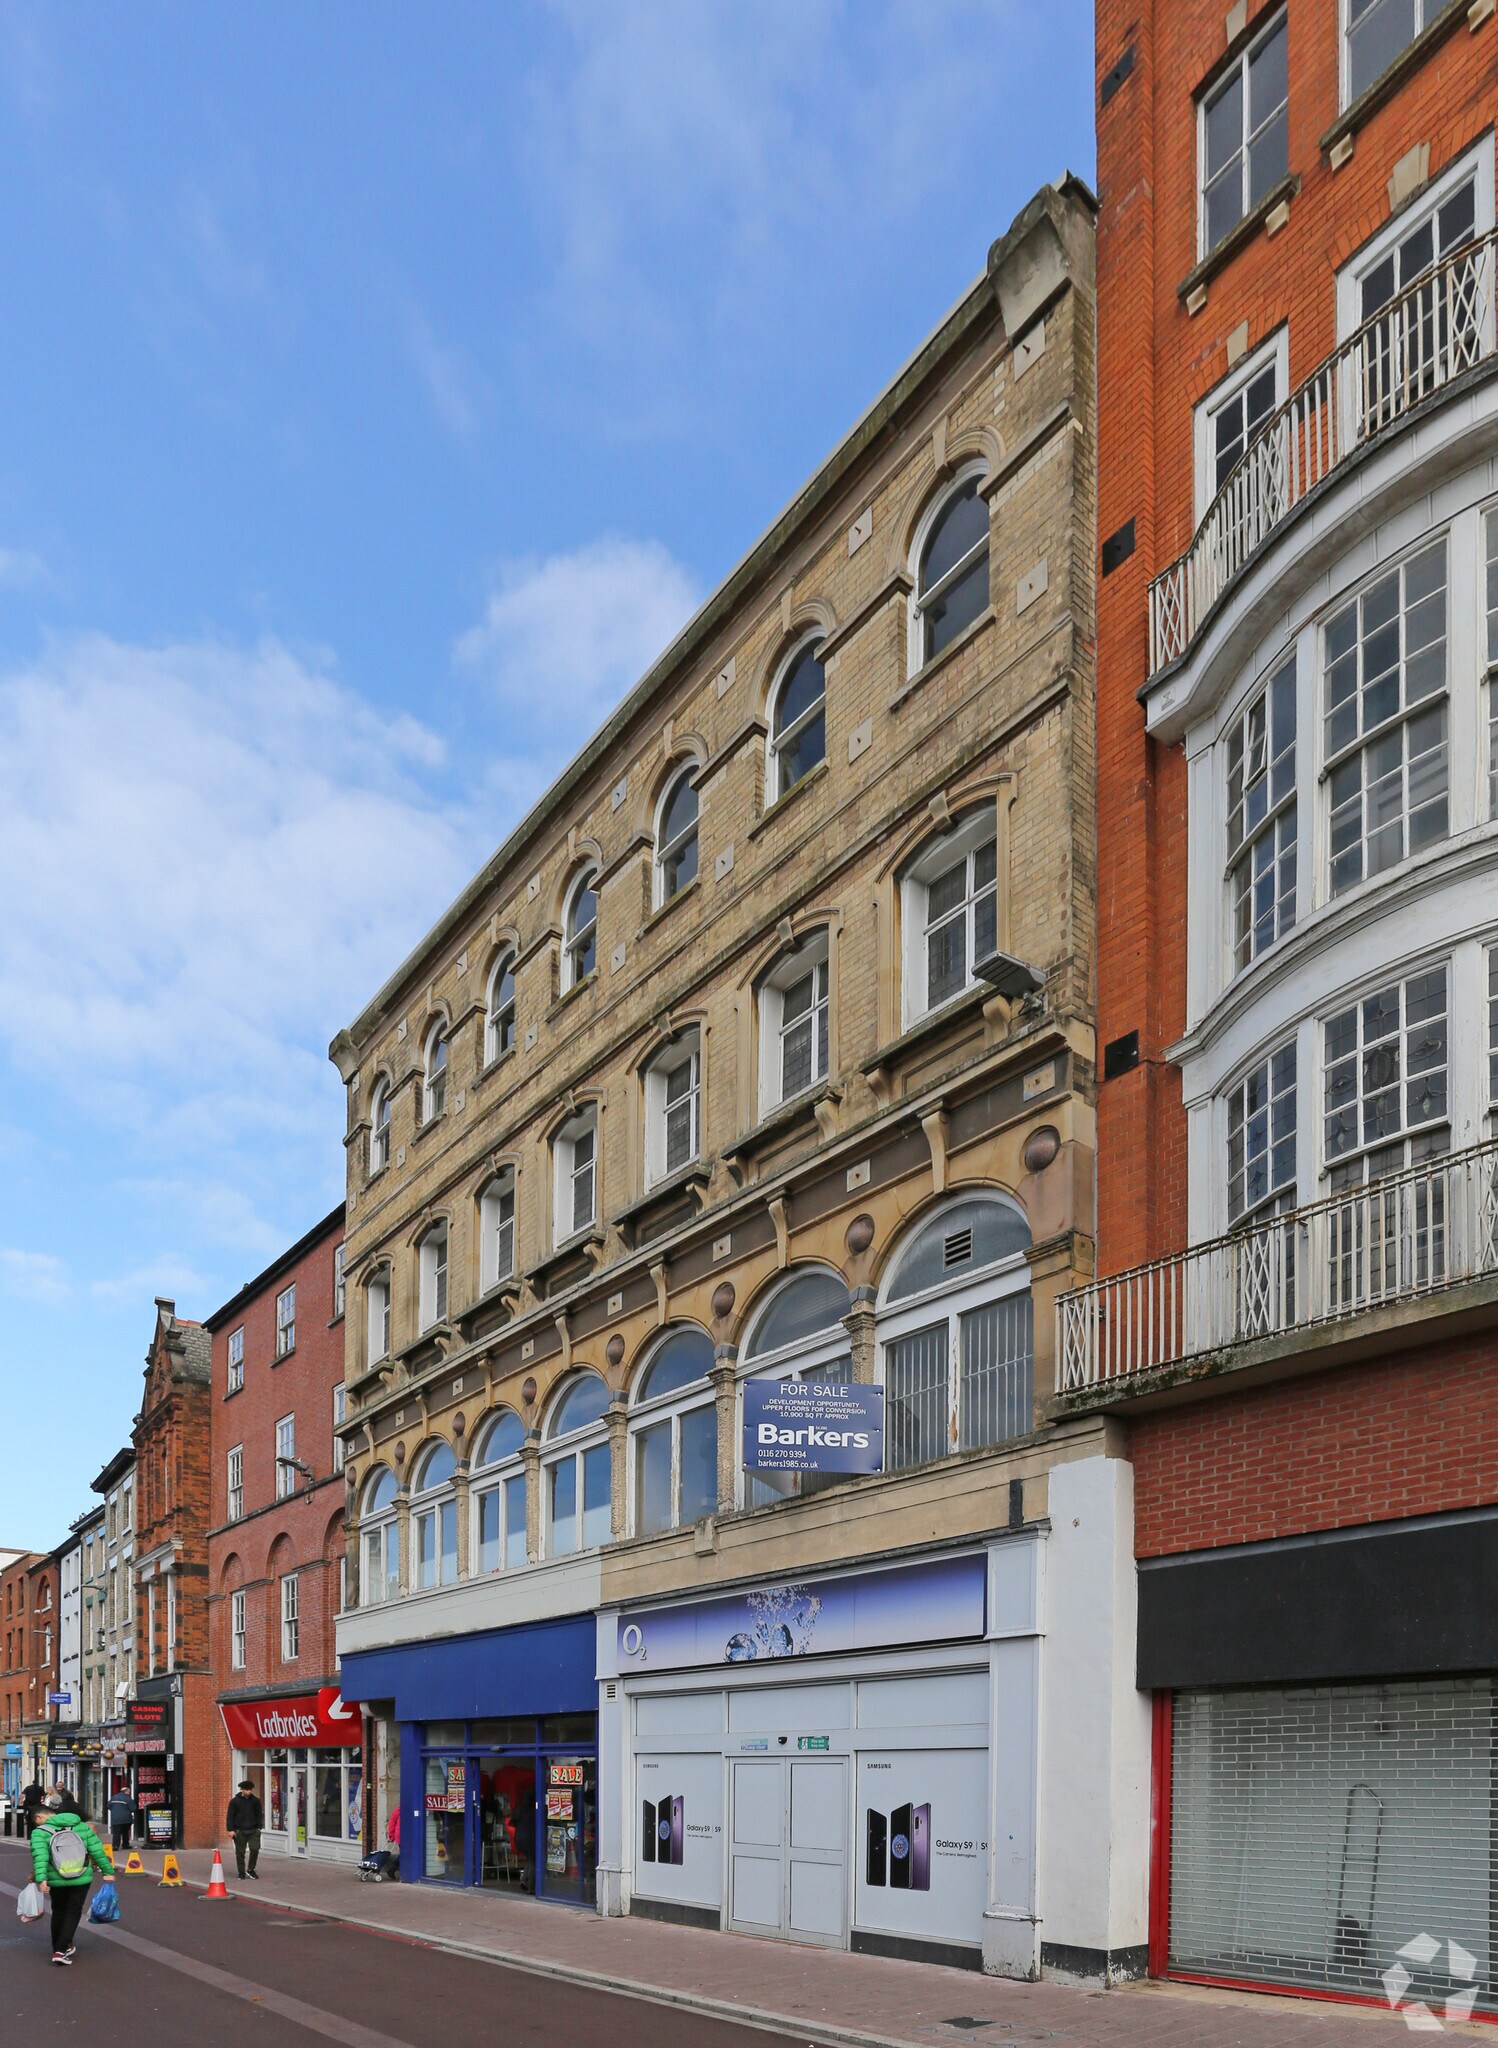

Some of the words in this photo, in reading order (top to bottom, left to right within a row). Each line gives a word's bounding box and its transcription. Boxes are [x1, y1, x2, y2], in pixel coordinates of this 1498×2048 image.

[780, 1384, 808, 1396] FOR
[813, 1386, 849, 1398] SALE
[758, 1423, 870, 1448] Barkers
[758, 1450, 774, 1458] 0116
[774, 1450, 788, 1458] 270
[789, 1450, 807, 1458] 9394
[758, 1460, 818, 1468] barkers1985.co.uk
[256, 1709, 318, 1738] Ladbrokes
[552, 1768, 581, 1782] SALE
[426, 1796, 448, 1808] SALE
[686, 1824, 704, 1832] Galaxy
[936, 1840, 963, 1850] Galaxy
[964, 1841, 973, 1850] S9
